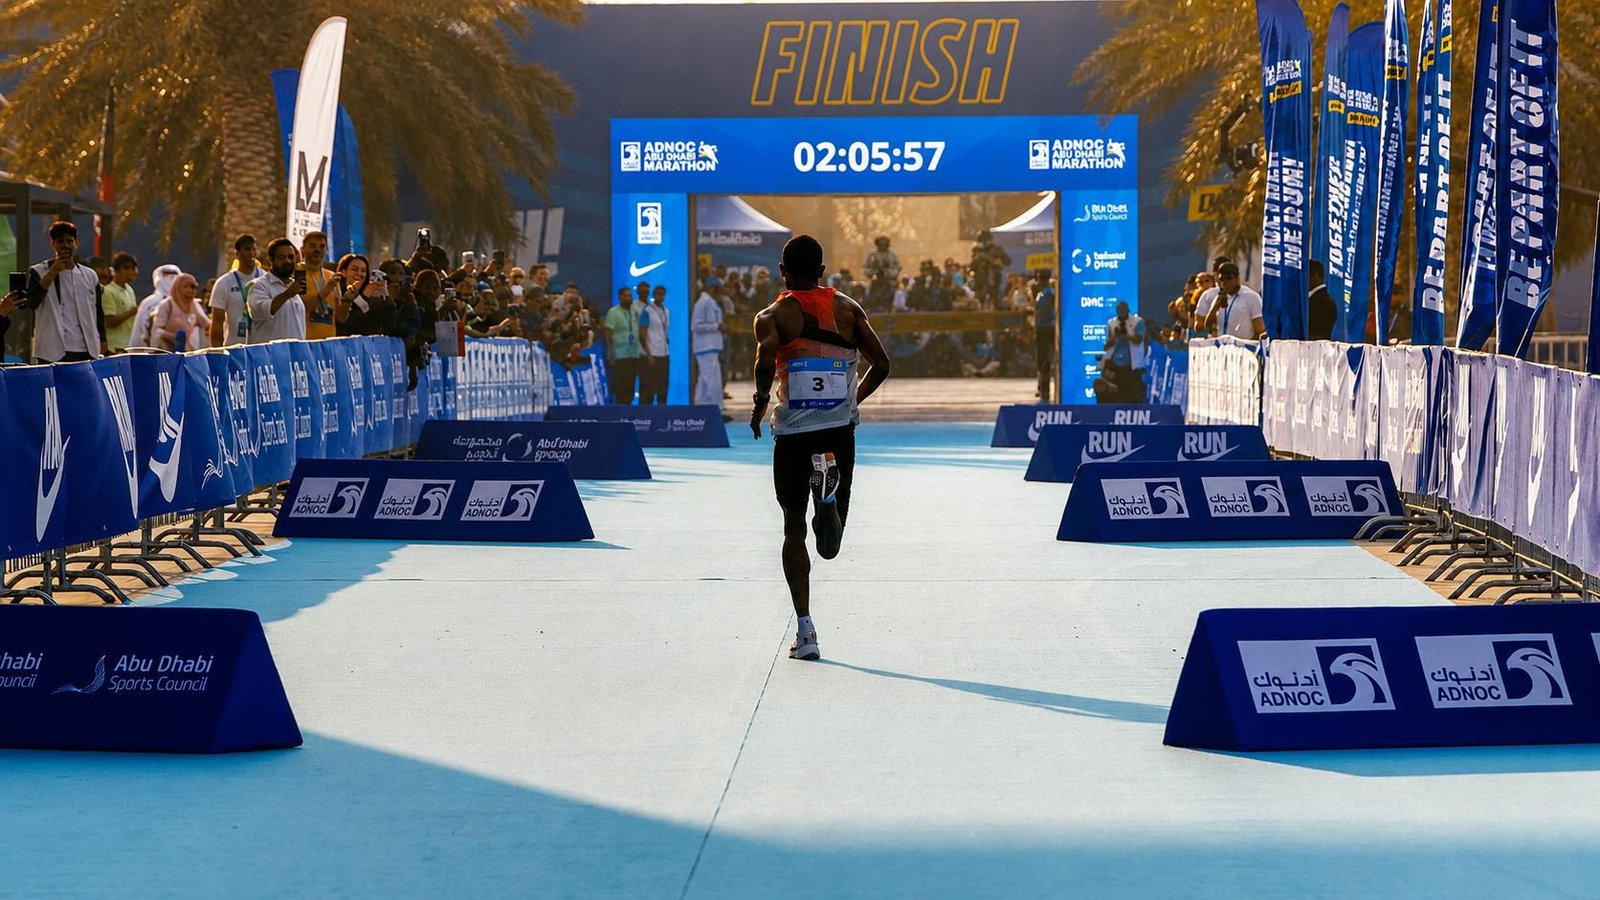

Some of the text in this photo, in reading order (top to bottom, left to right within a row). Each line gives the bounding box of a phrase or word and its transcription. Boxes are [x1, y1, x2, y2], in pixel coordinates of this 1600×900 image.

[751, 17, 1019, 105] FINISH
[644, 141, 696, 152] ADNOC
[1052, 139, 1104, 150] ADNOC
[644, 152, 696, 161] ABU DHABI
[793, 141, 946, 172] 02:05:57
[1052, 150, 1104, 159] ABU DHABI
[643, 160, 716, 172] MARATHON
[1052, 158, 1124, 169] MARATHON
[1507, 18, 1544, 309] BE PART OF IT
[295, 151, 329, 215] M
[1283, 227, 1303, 270] WE
[812, 377, 824, 392] 3
[1035, 411, 1073, 424] RUN
[1115, 410, 1151, 425] RUN
[559, 438, 589, 449] Dhabi
[1089, 431, 1132, 454] RUN
[1185, 431, 1227, 454] RUN
[293, 505, 326, 514] ADNOC
[378, 506, 412, 516] ADNOC
[465, 508, 499, 517] ADNOC
[1112, 506, 1150, 516] ADNOC
[1213, 504, 1250, 514] ADNOC
[1313, 503, 1350, 513] ADNOC
[0, 652, 44, 670] habi
[114, 655, 215, 673] Abu Dhabi
[108, 675, 209, 693] Sports Council
[1260, 691, 1325, 707] ADNOC
[1437, 686, 1501, 701] ADNOC
